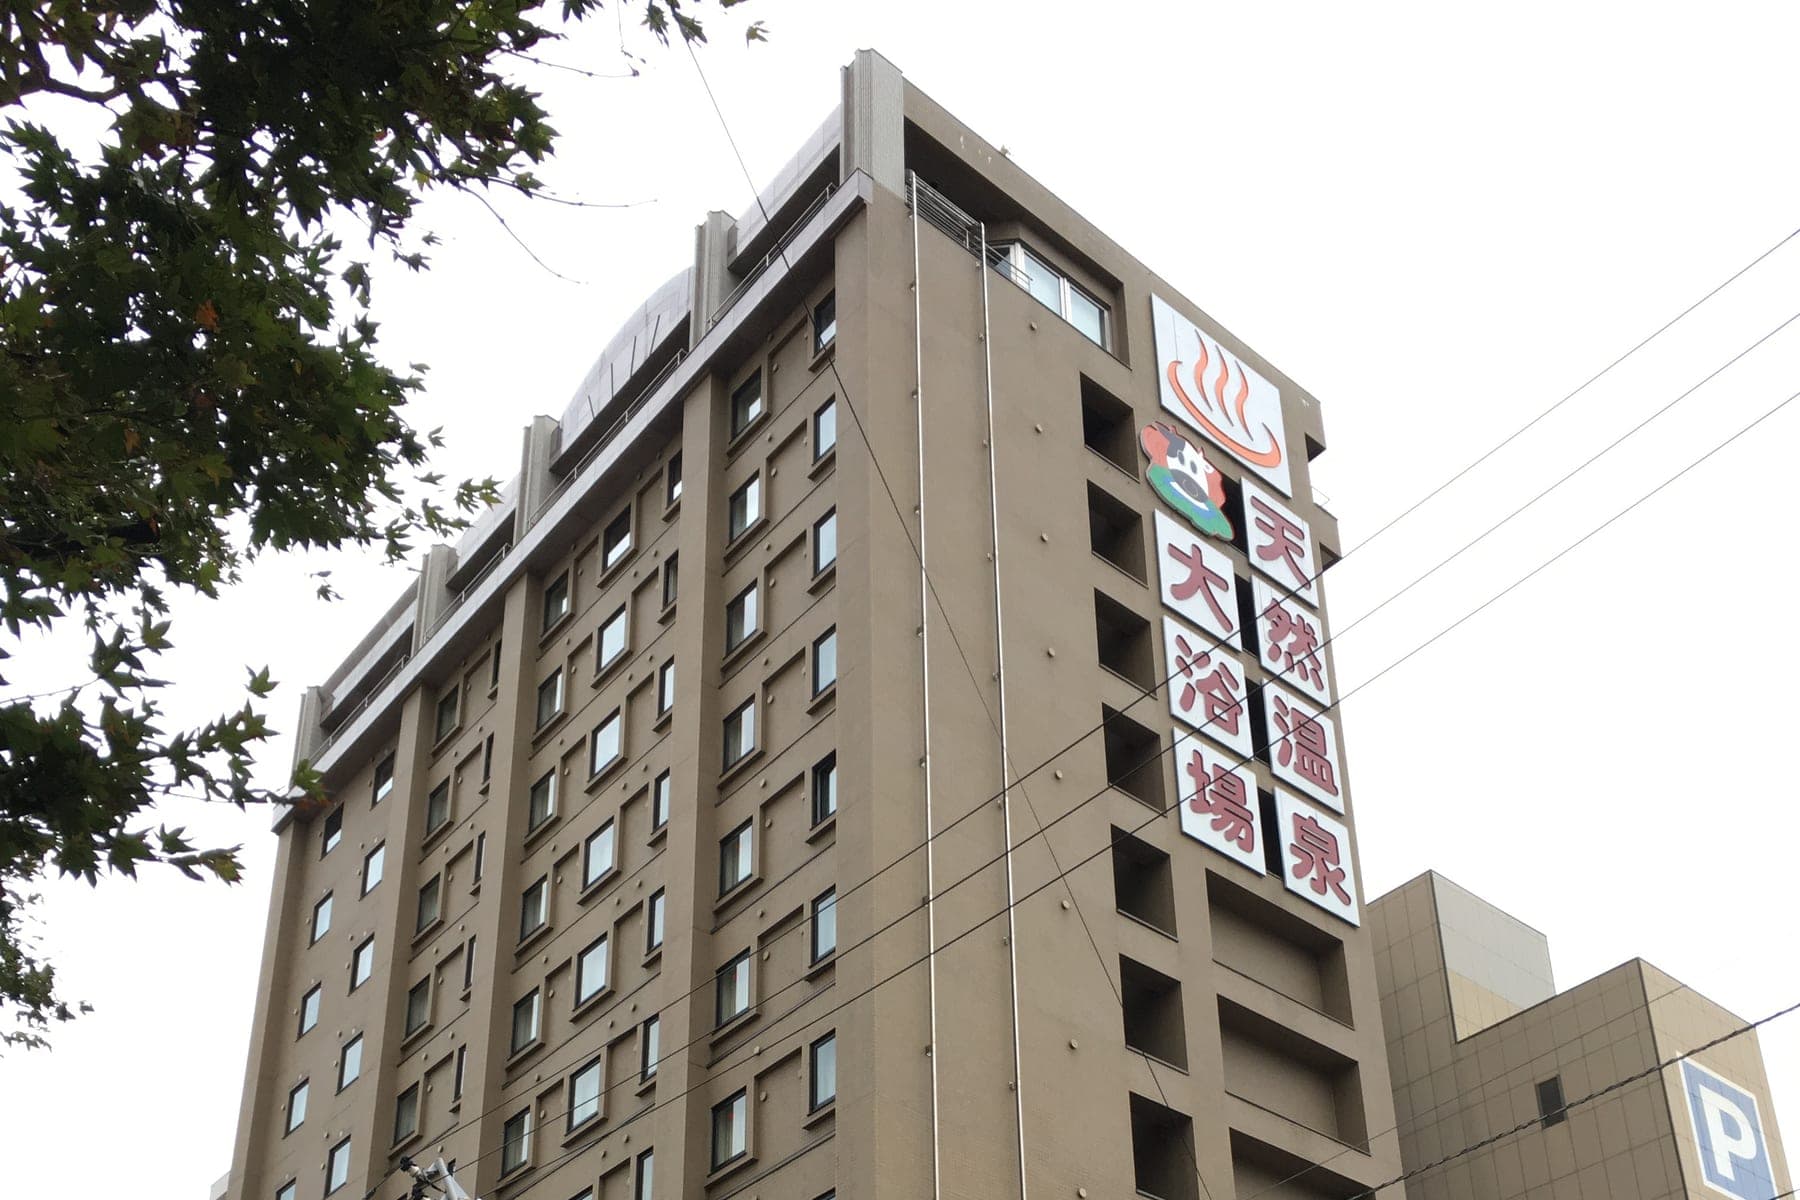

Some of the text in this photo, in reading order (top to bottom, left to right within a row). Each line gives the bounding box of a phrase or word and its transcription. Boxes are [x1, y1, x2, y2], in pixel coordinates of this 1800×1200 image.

[1167, 541, 1256, 854] 大浴場
[1250, 495, 1352, 906] 天然温泉
[1698, 1083, 1757, 1183] P
